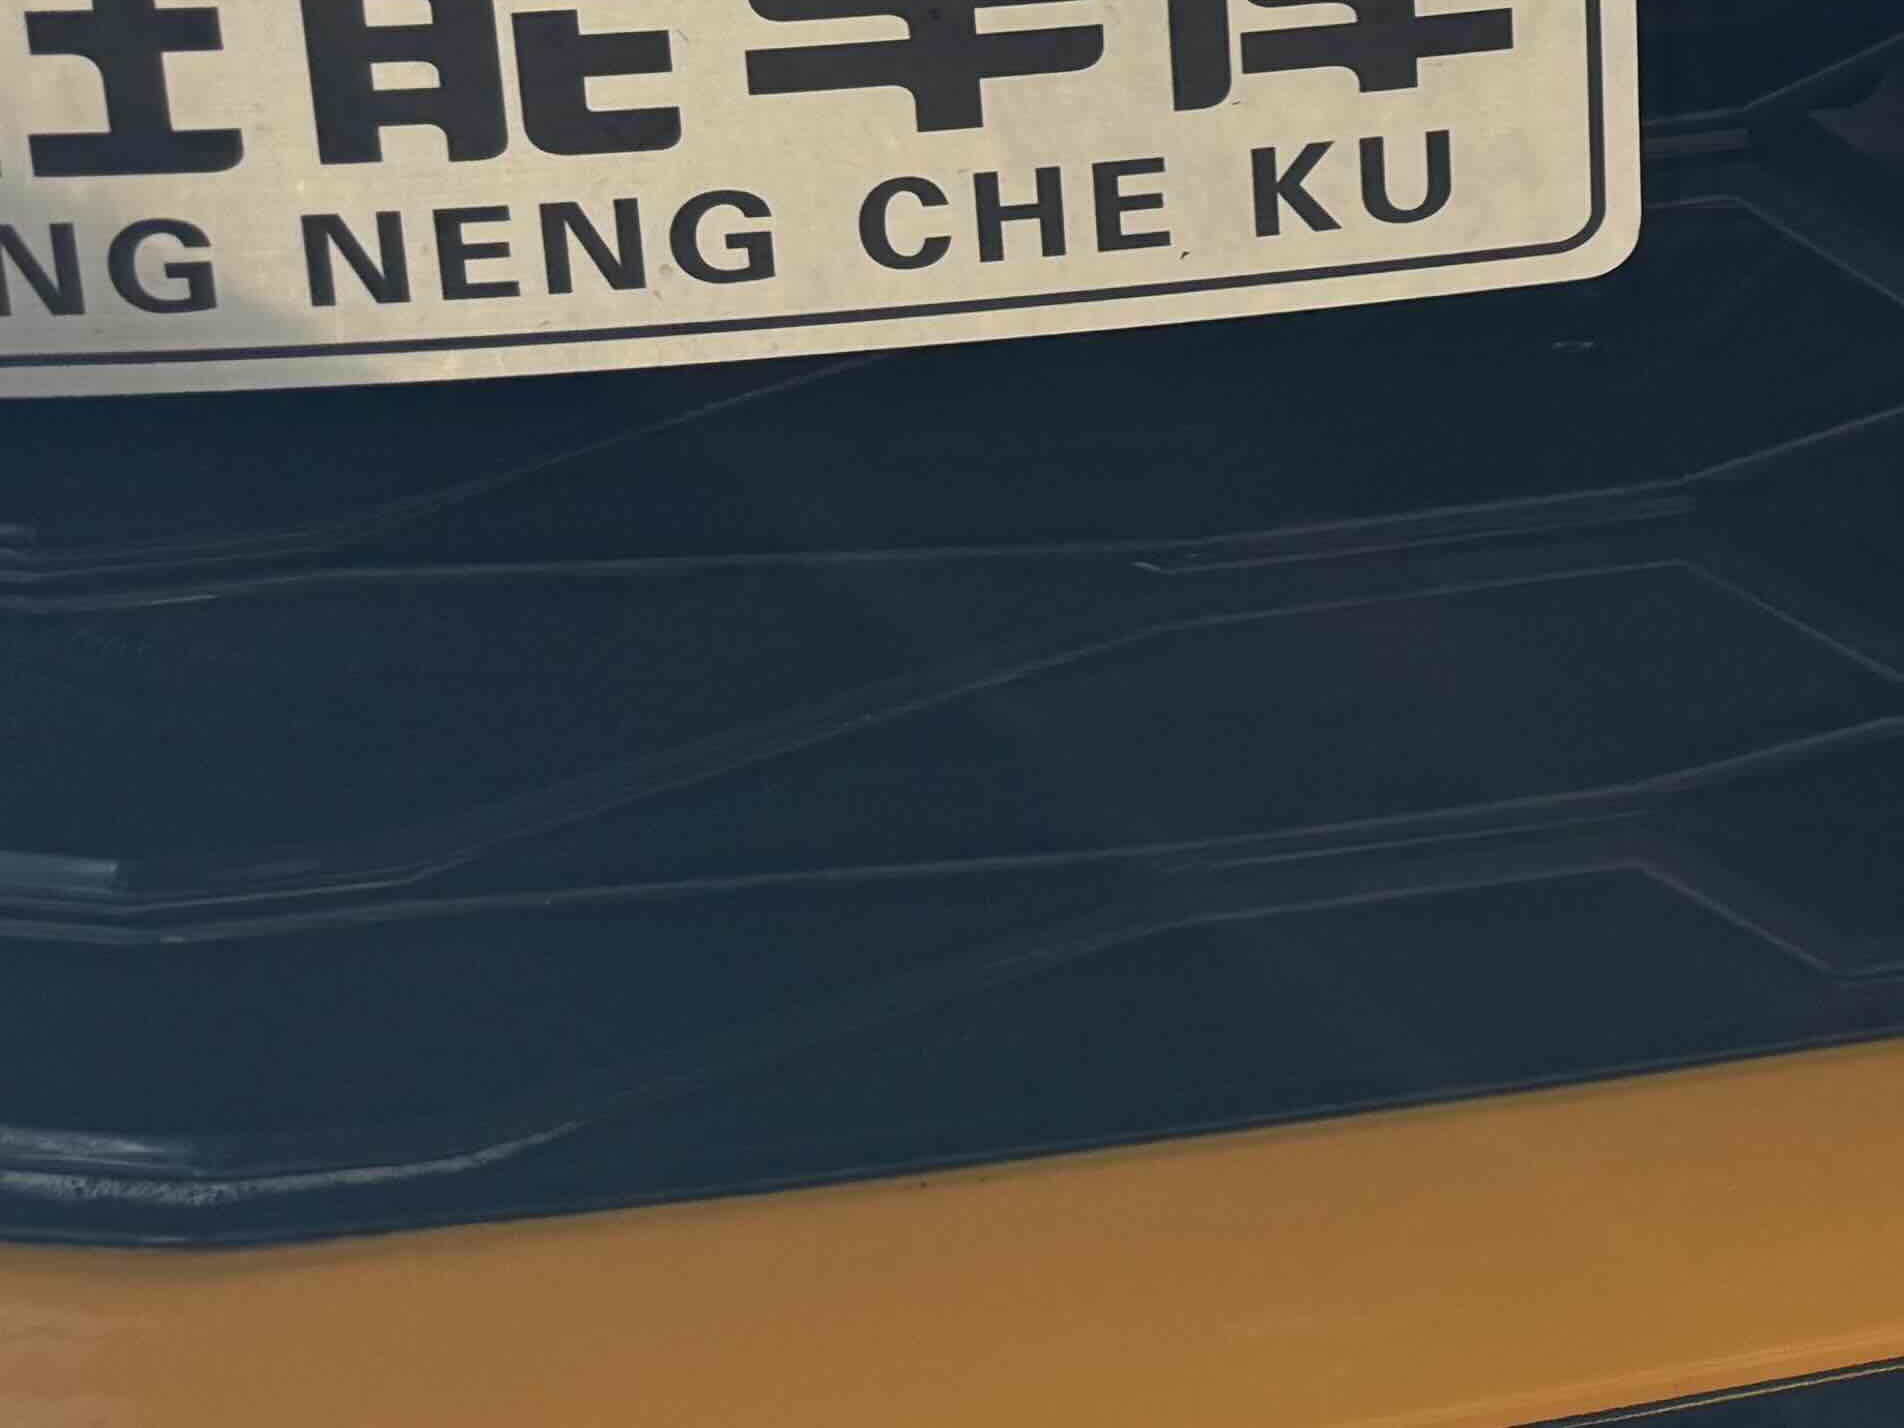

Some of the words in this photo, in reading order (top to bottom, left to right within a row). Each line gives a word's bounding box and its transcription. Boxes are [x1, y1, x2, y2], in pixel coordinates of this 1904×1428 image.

[300, 189, 777, 308] NENG
[858, 156, 1173, 272] CHE
[1249, 127, 1455, 238] KU
